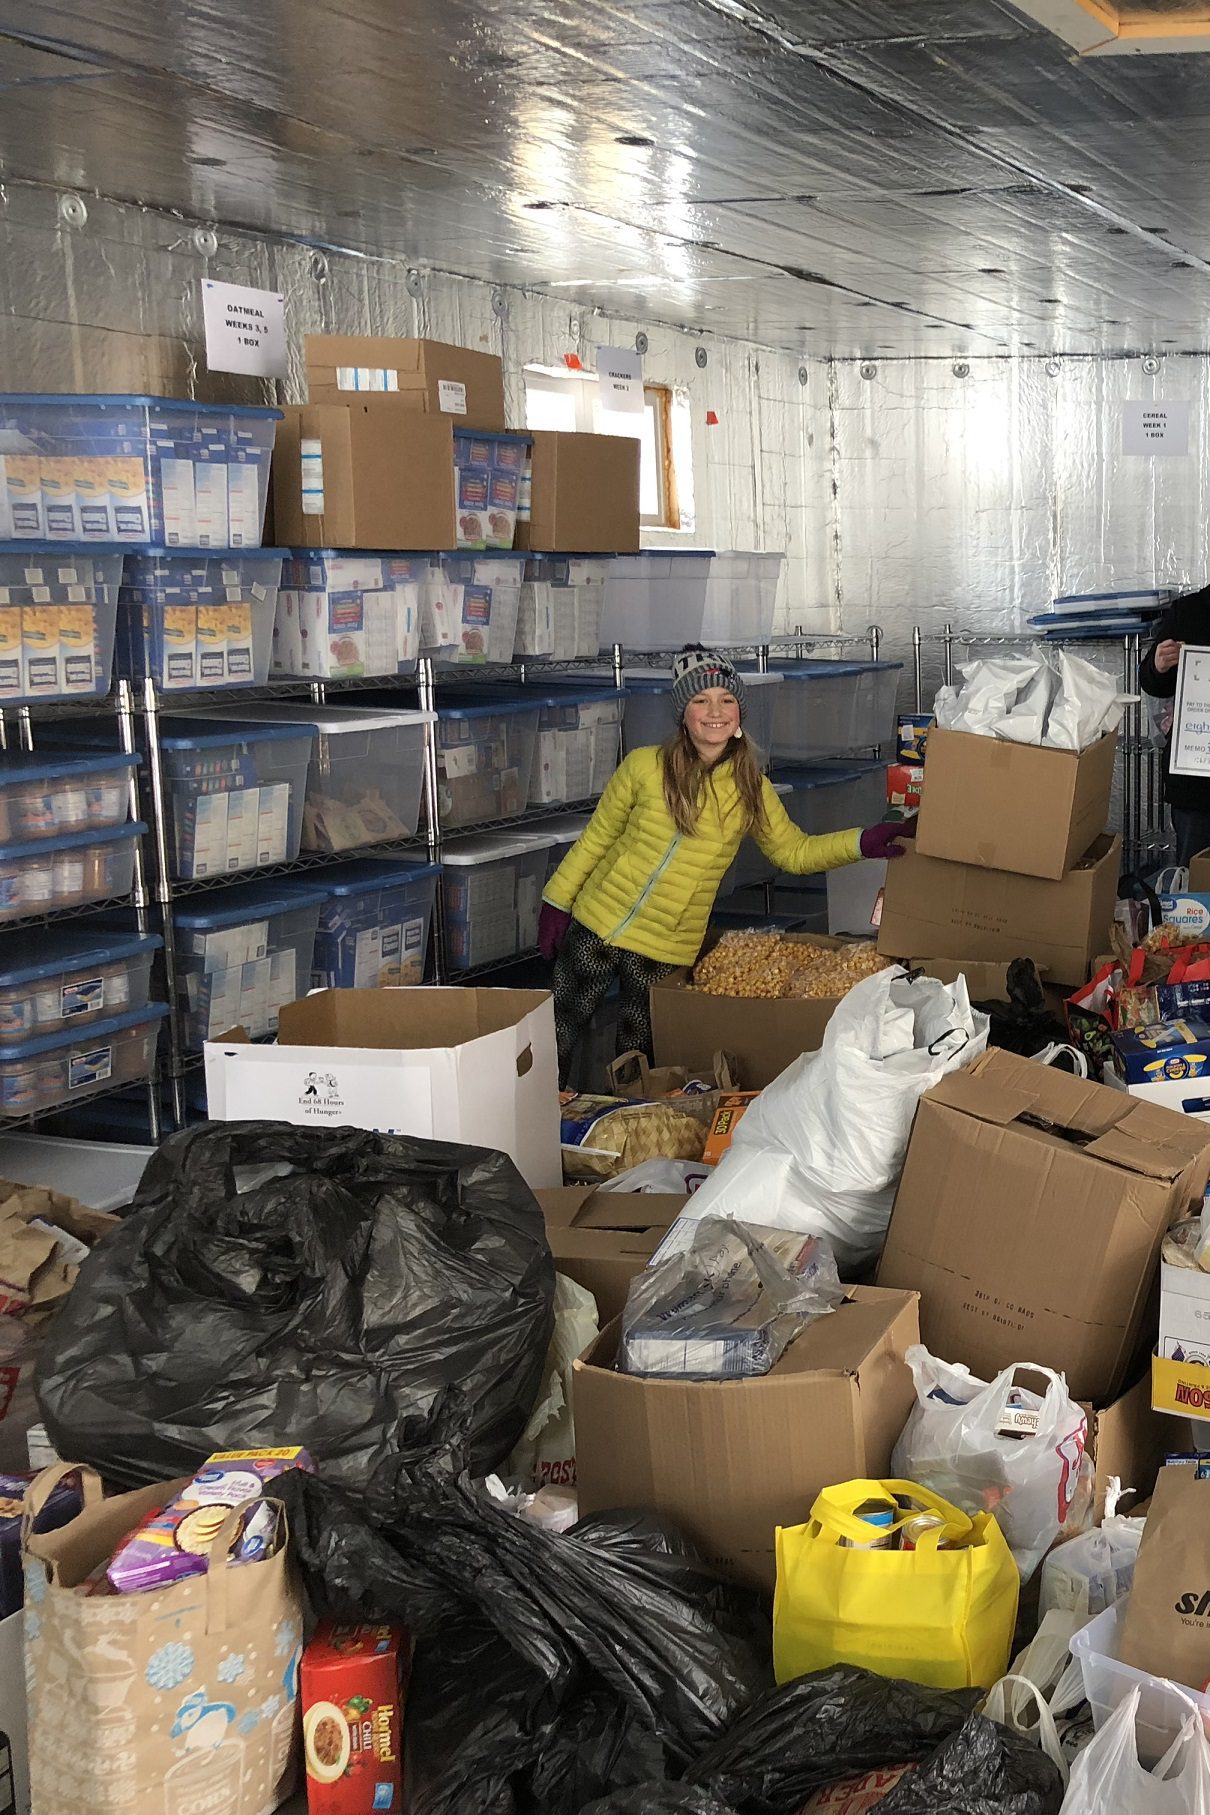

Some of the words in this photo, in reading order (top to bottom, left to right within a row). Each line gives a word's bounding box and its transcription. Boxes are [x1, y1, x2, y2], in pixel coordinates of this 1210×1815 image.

[227, 304, 264, 318] OATMEAL
[225, 320, 253, 331] WEEKS
[244, 338, 259, 347] BOX
[1185, 744, 1206, 753] MEMO
[1186, 907, 1204, 915] Rice
[1163, 914, 1204, 923] Squares
[313, 1107, 339, 1116] Hunger
[213, 1451, 246, 1461] VALUE
[247, 1450, 274, 1459] PACK
[275, 1449, 290, 1457] 20
[1181, 1617, 1205, 1628] You're
[362, 1720, 373, 1750] CHILI
[378, 1703, 396, 1763] Hormel
